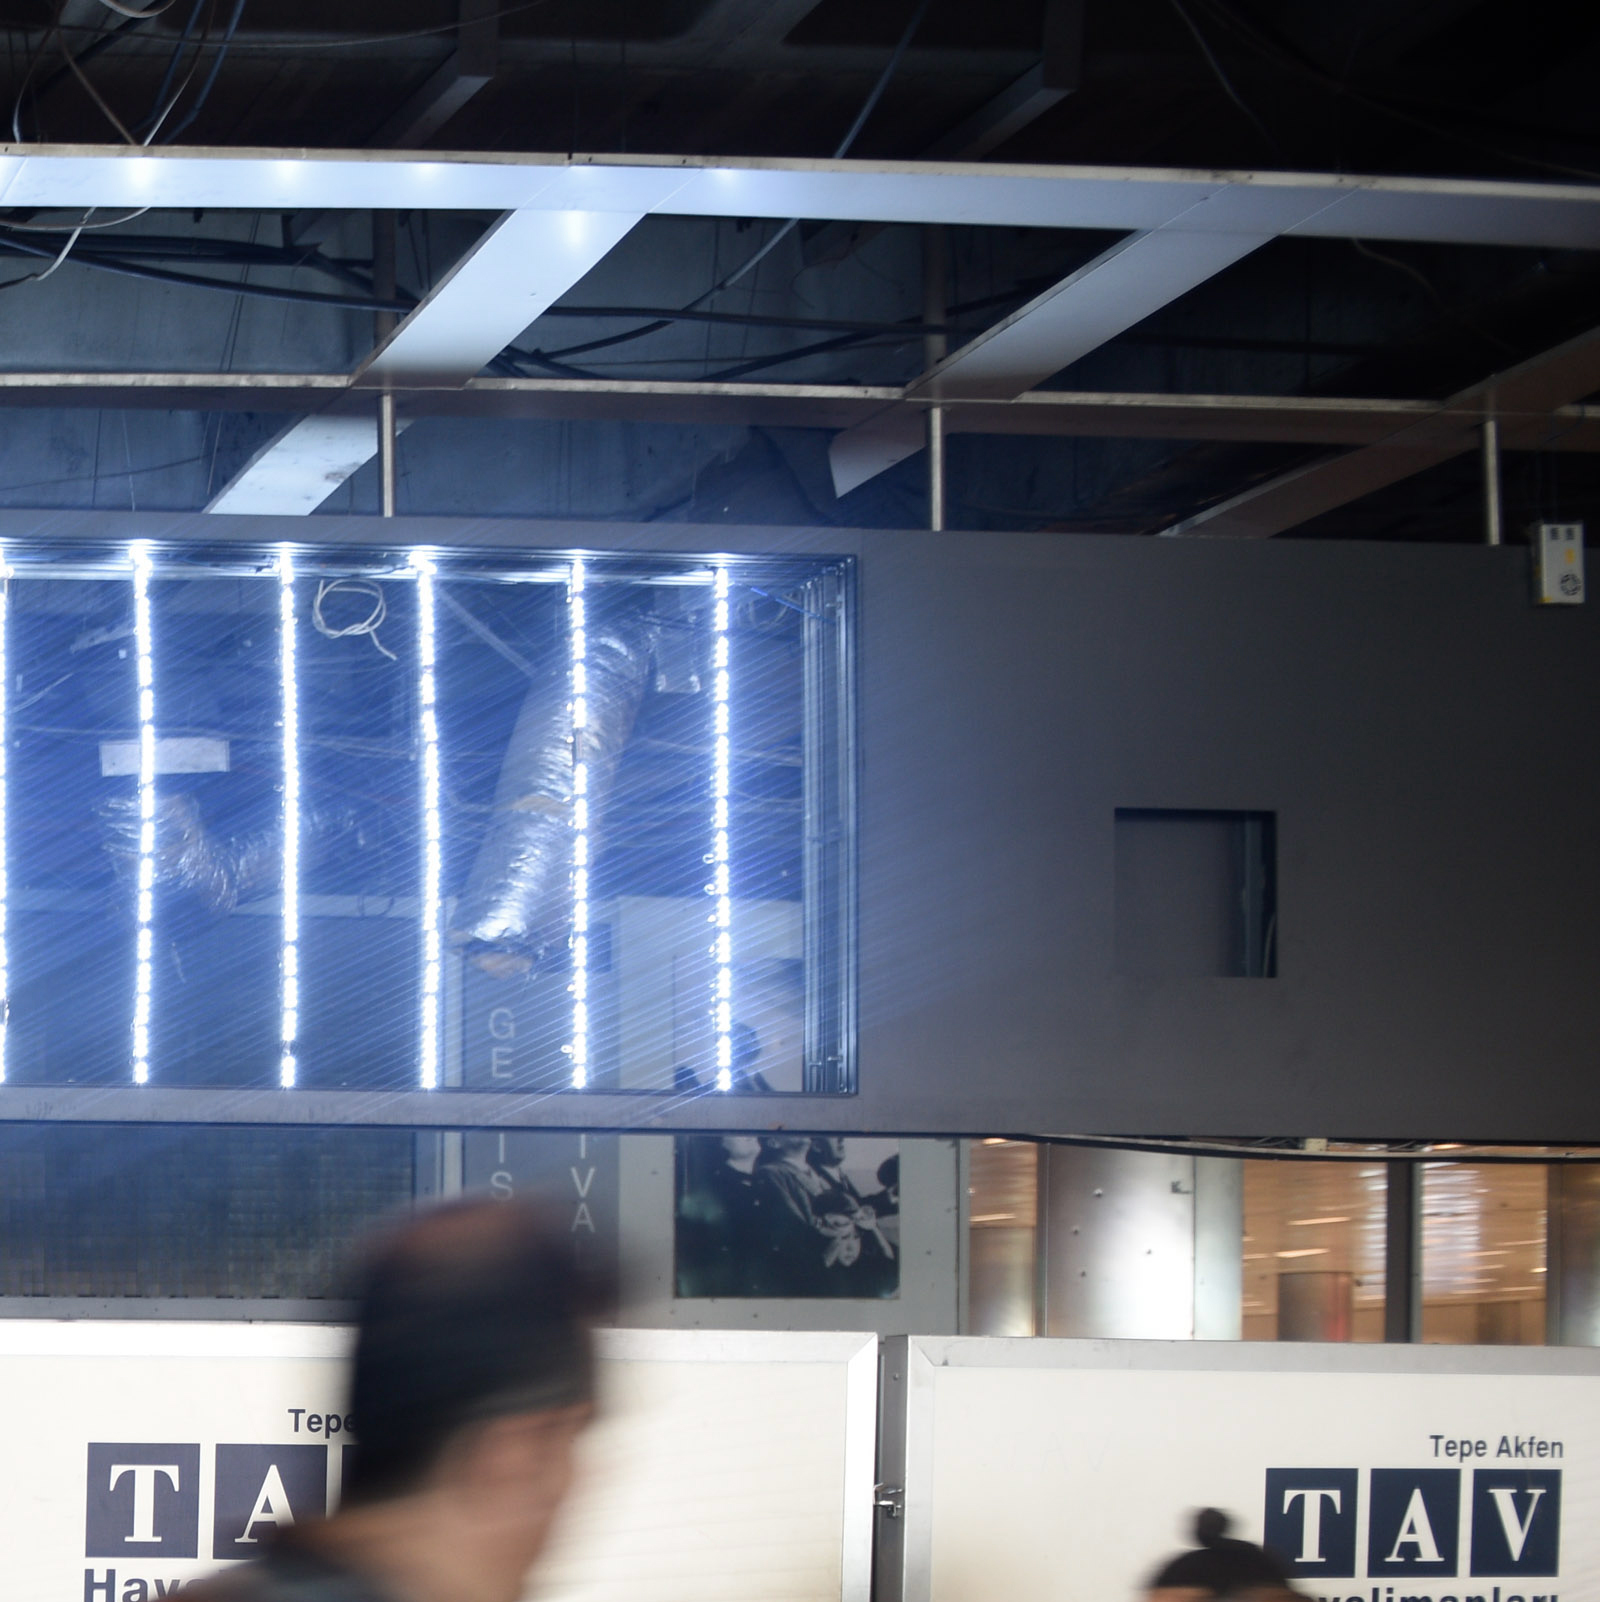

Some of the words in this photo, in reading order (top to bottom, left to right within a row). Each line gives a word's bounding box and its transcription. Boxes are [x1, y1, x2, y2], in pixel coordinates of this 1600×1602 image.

[1429, 1434, 1488, 1462] Tepe
[1496, 1433, 1564, 1459] Akfen
[1282, 1486, 1547, 1563] TAV
